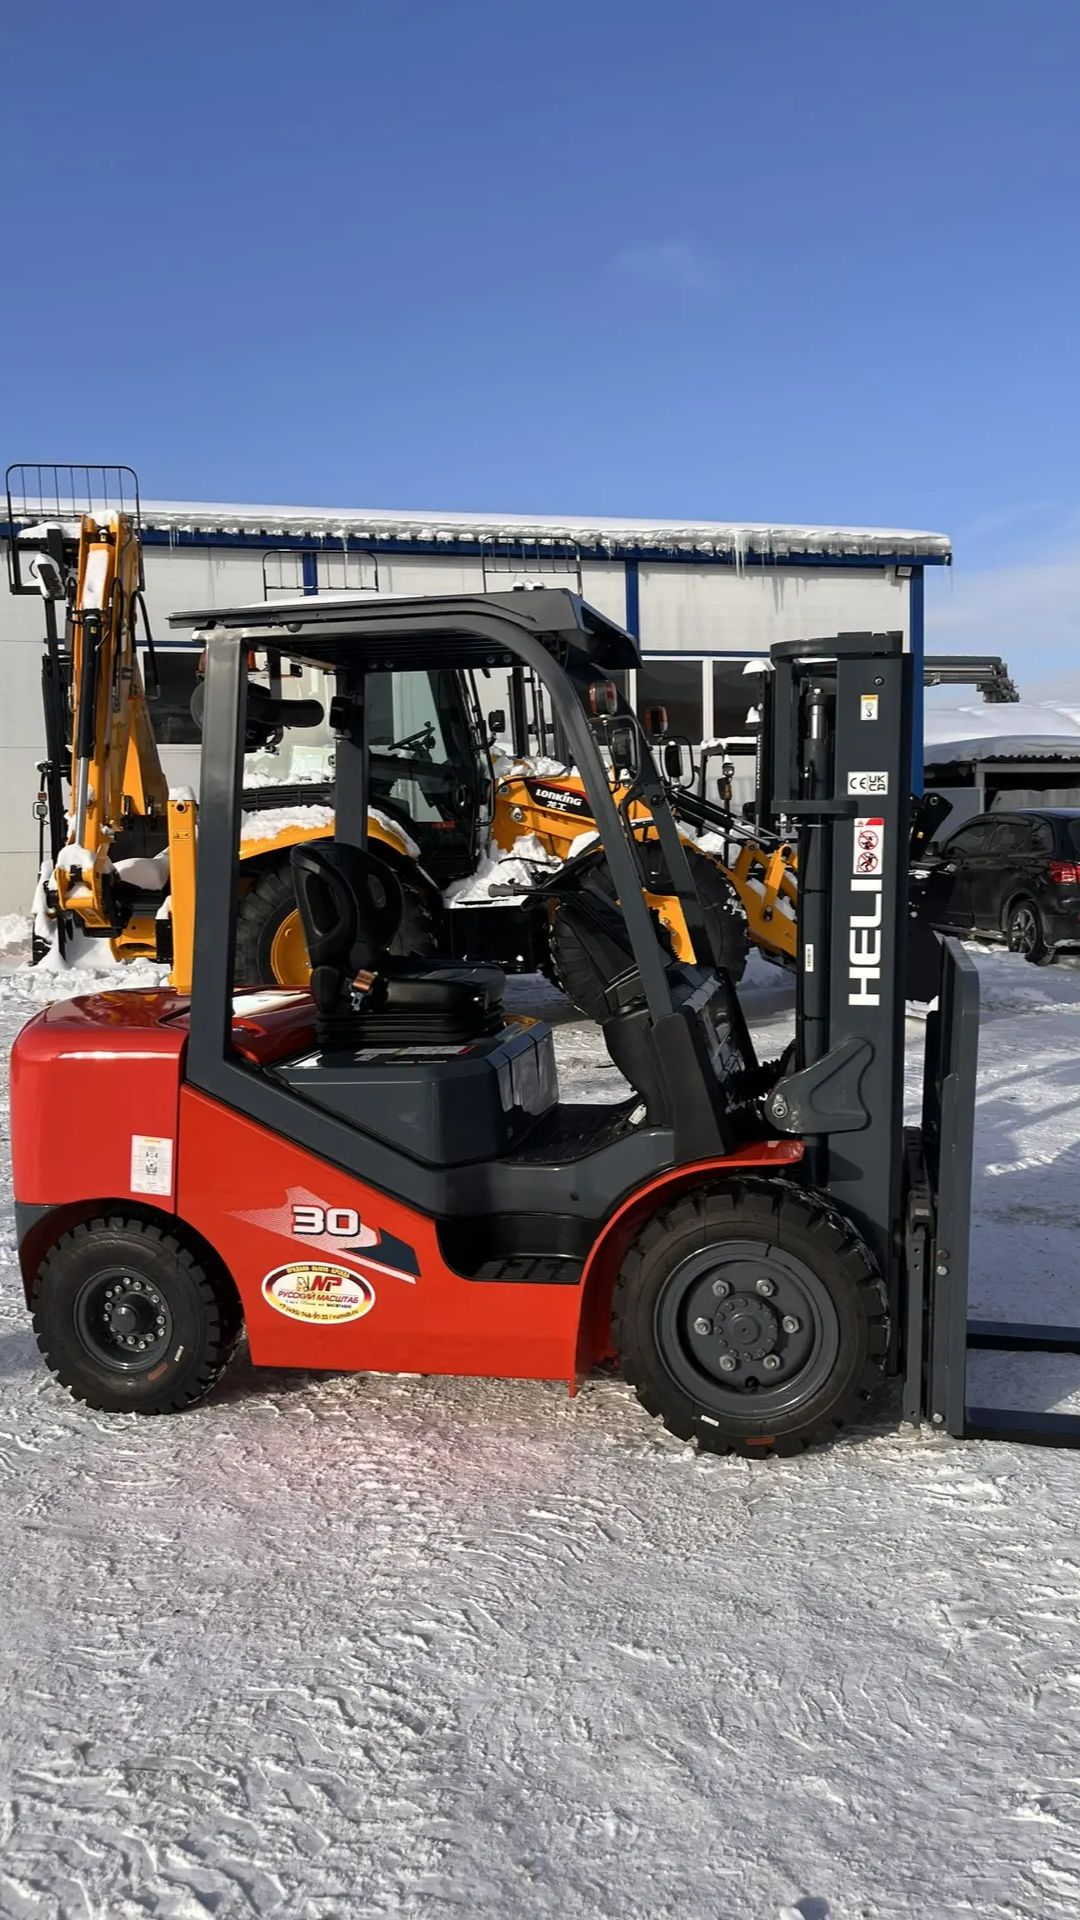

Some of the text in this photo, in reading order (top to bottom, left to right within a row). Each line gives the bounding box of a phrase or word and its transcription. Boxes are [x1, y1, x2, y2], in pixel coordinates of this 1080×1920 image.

[850, 777, 867, 790] CE
[869, 775, 886, 783] UK
[848, 879, 883, 1006] HELI
[291, 1204, 361, 1237] 30
[278, 1290, 360, 1304] РУССКИЙ МАСШТАБ
